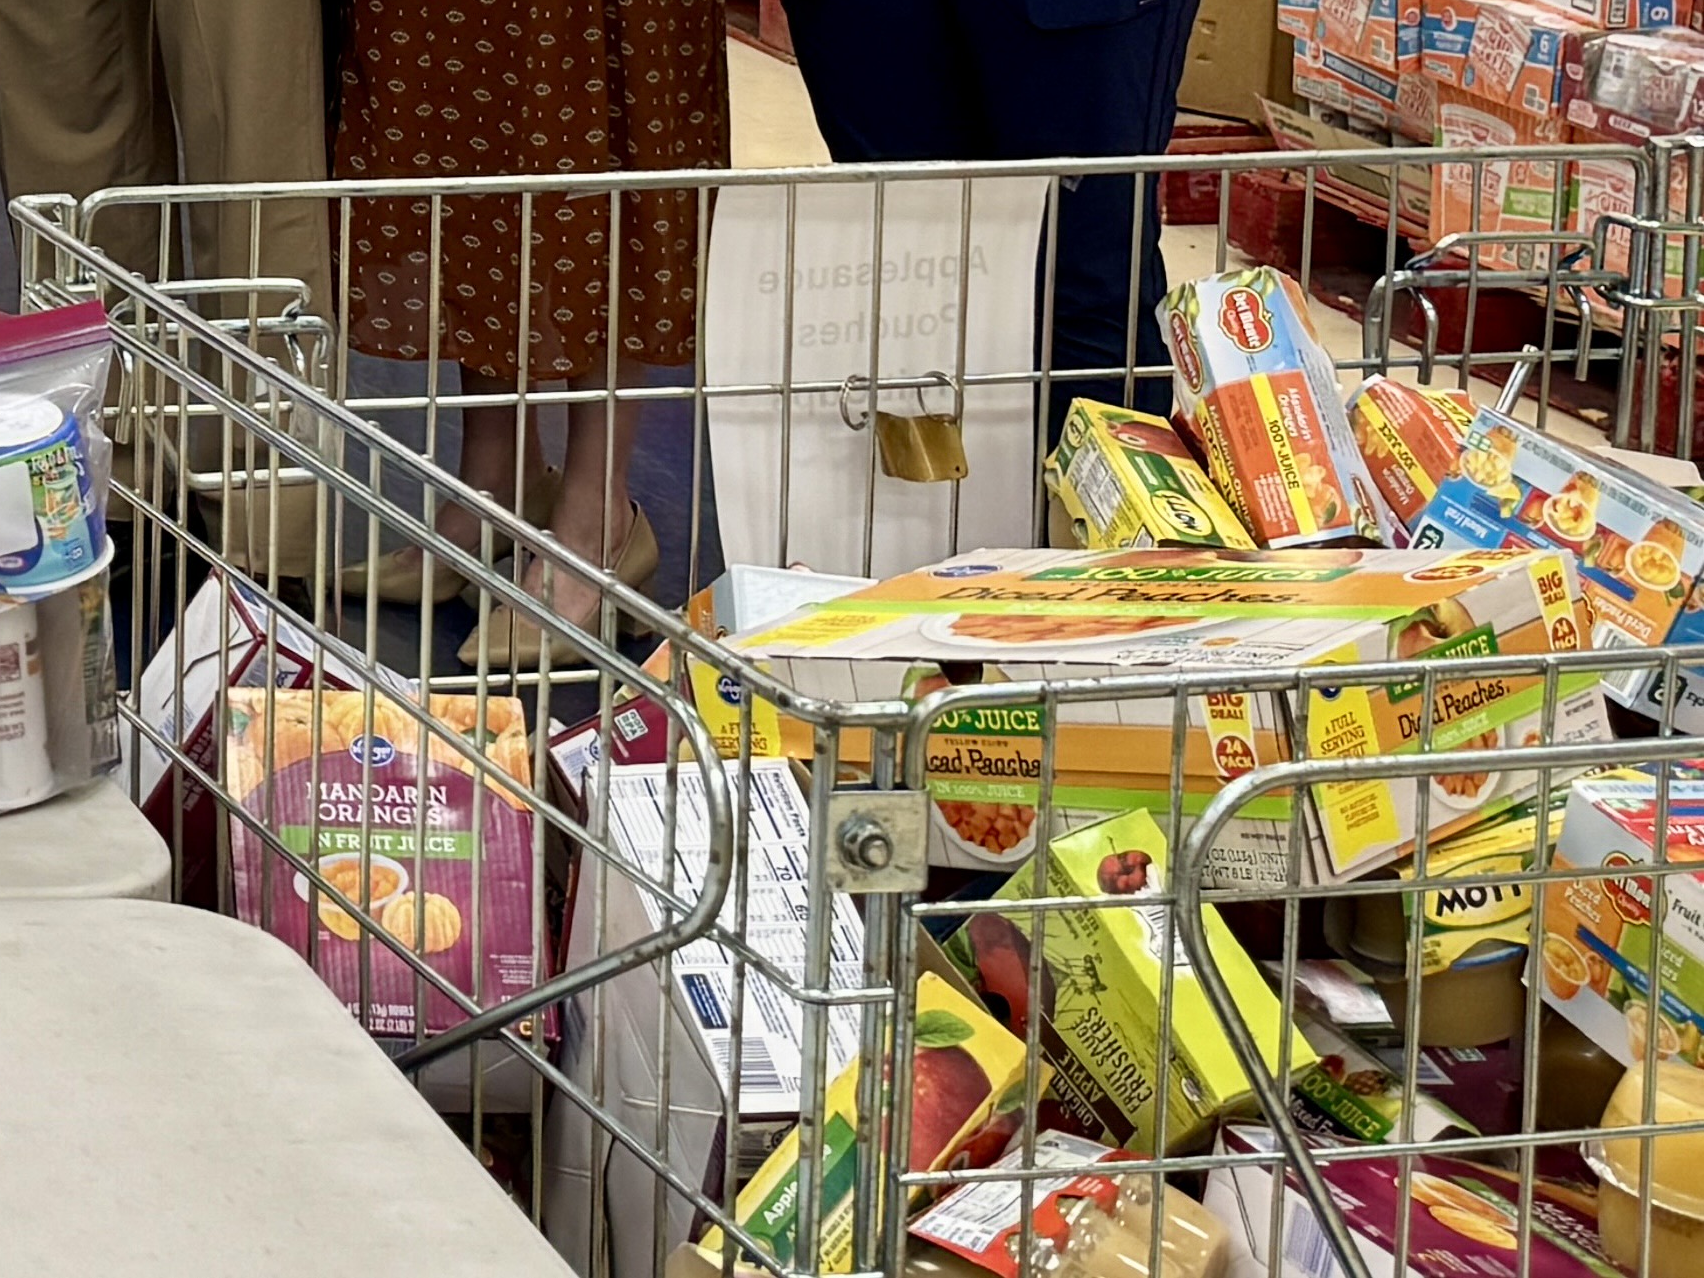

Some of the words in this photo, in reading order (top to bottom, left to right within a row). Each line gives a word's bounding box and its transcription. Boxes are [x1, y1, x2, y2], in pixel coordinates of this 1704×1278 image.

[1279, 450, 1300, 490] JUICE
[1081, 565, 1187, 582] 100%
[1189, 564, 1323, 582] JUICE
[1537, 570, 1564, 595] BIG
[939, 587, 1089, 602] Diced
[975, 709, 1041, 732] JUICE
[1398, 708, 1441, 739] Dicd
[1219, 755, 1253, 770] PACK
[1224, 739, 1243, 755] 24
[306, 781, 448, 805] MANDARN
[1672, 897, 1701, 927] Fruit
[1076, 1014, 1111, 1068] SAUCE
[1084, 1006, 1154, 1103] CRUSHERS
[1056, 1053, 1104, 1104] APPLE
[1104, 1067, 1144, 1116] FRUIT
[1050, 1072, 1093, 1127] ORGANI
[1334, 1093, 1393, 1138] JUICE
[763, 1180, 798, 1226] Apple
